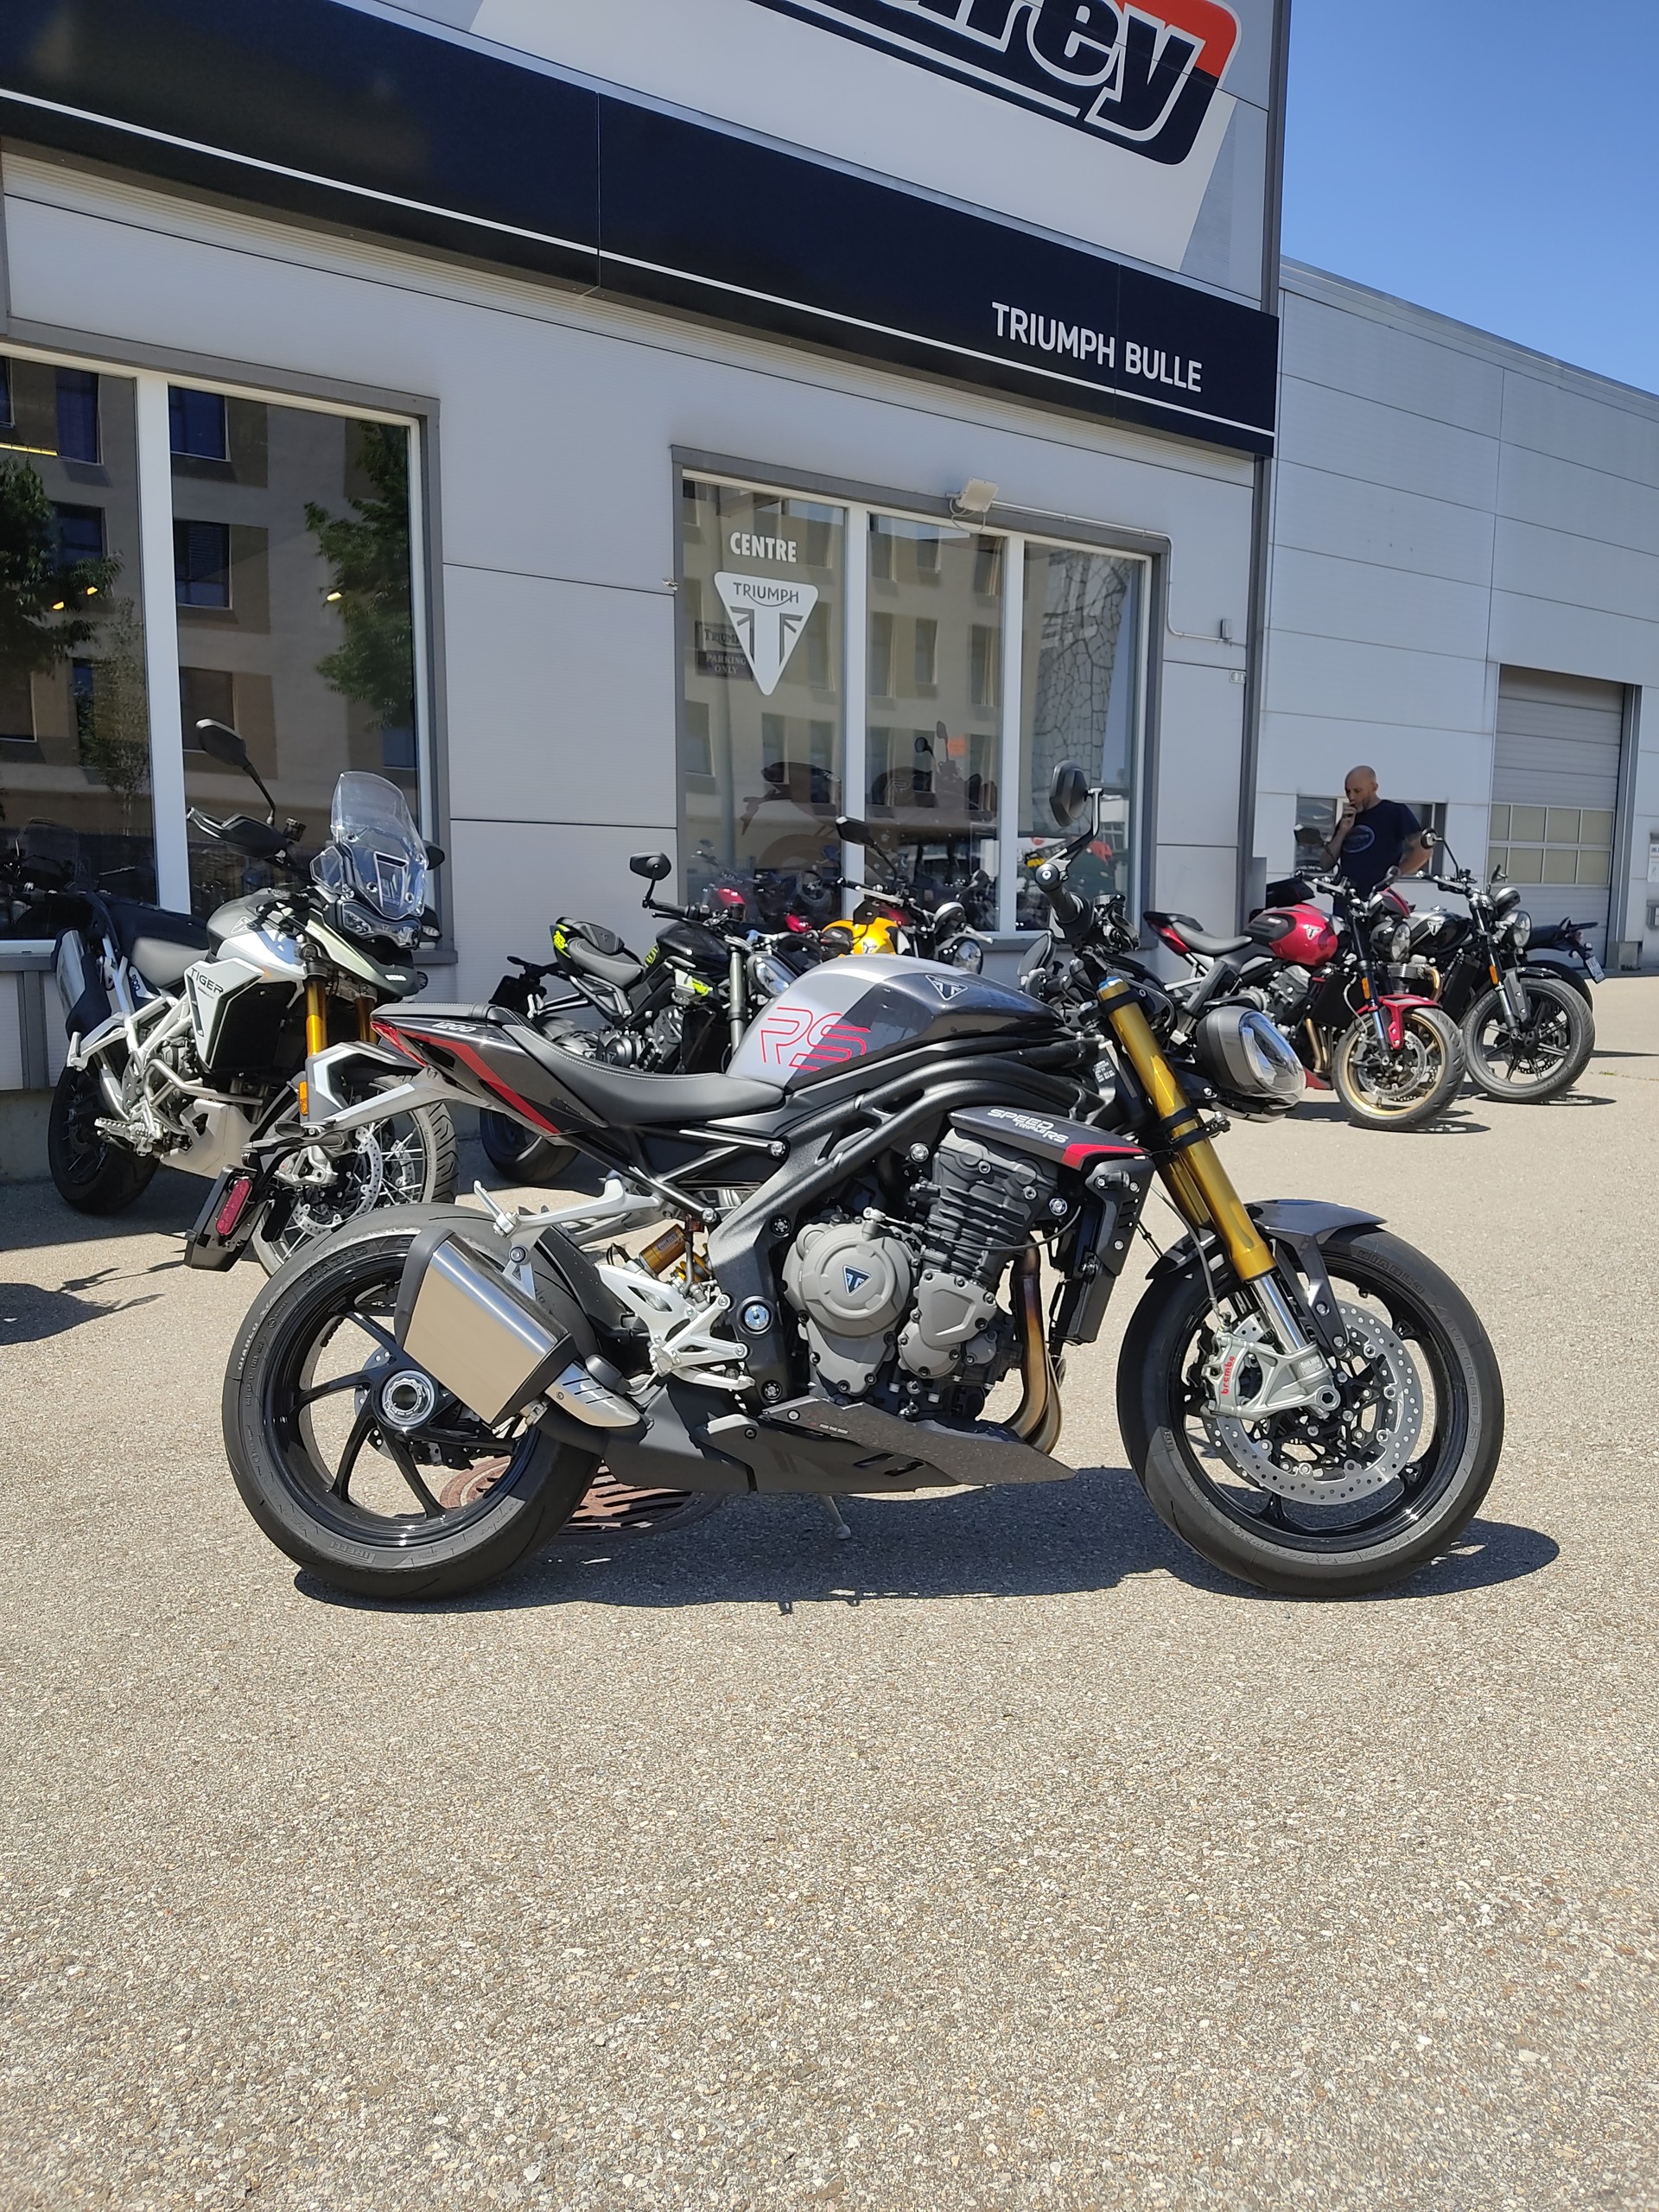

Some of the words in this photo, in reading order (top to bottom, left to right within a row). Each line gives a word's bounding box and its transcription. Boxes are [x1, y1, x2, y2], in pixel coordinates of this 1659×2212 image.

[992, 301, 1116, 369] TRIUMPH
[1125, 340, 1203, 393] BULLE
[729, 531, 798, 563] CENTRE
[733, 582, 799, 607] TRIUMPH
[706, 653, 747, 665] PARKING
[714, 664, 738, 674] ONLY
[190, 967, 224, 995] TIGER
[431, 1021, 478, 1033] 1200
[760, 1006, 872, 1072] RS
[987, 1109, 1055, 1130] SPEED
[1042, 1130, 1070, 1144] RS
[1221, 1356, 1236, 1395] brembo
